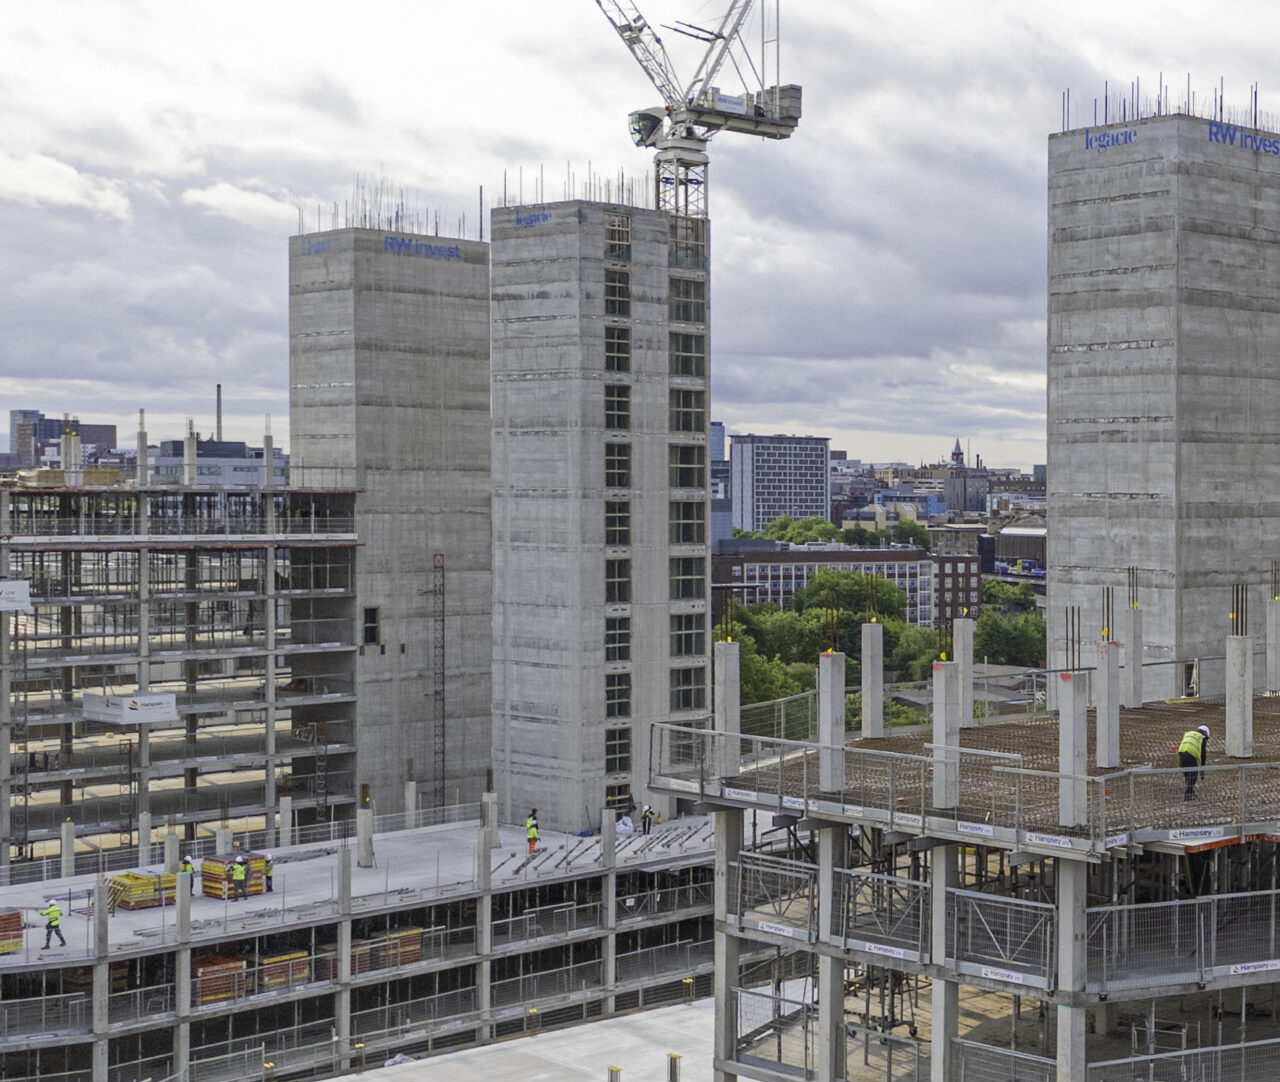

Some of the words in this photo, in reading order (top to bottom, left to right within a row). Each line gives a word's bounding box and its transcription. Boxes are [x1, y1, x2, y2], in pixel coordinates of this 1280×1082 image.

[1085, 124, 1137, 154] legacie
[1208, 121, 1237, 146] RW
[383, 235, 413, 253] RW
[415, 240, 461, 260] invest
[1179, 828, 1212, 838] Hampsey
